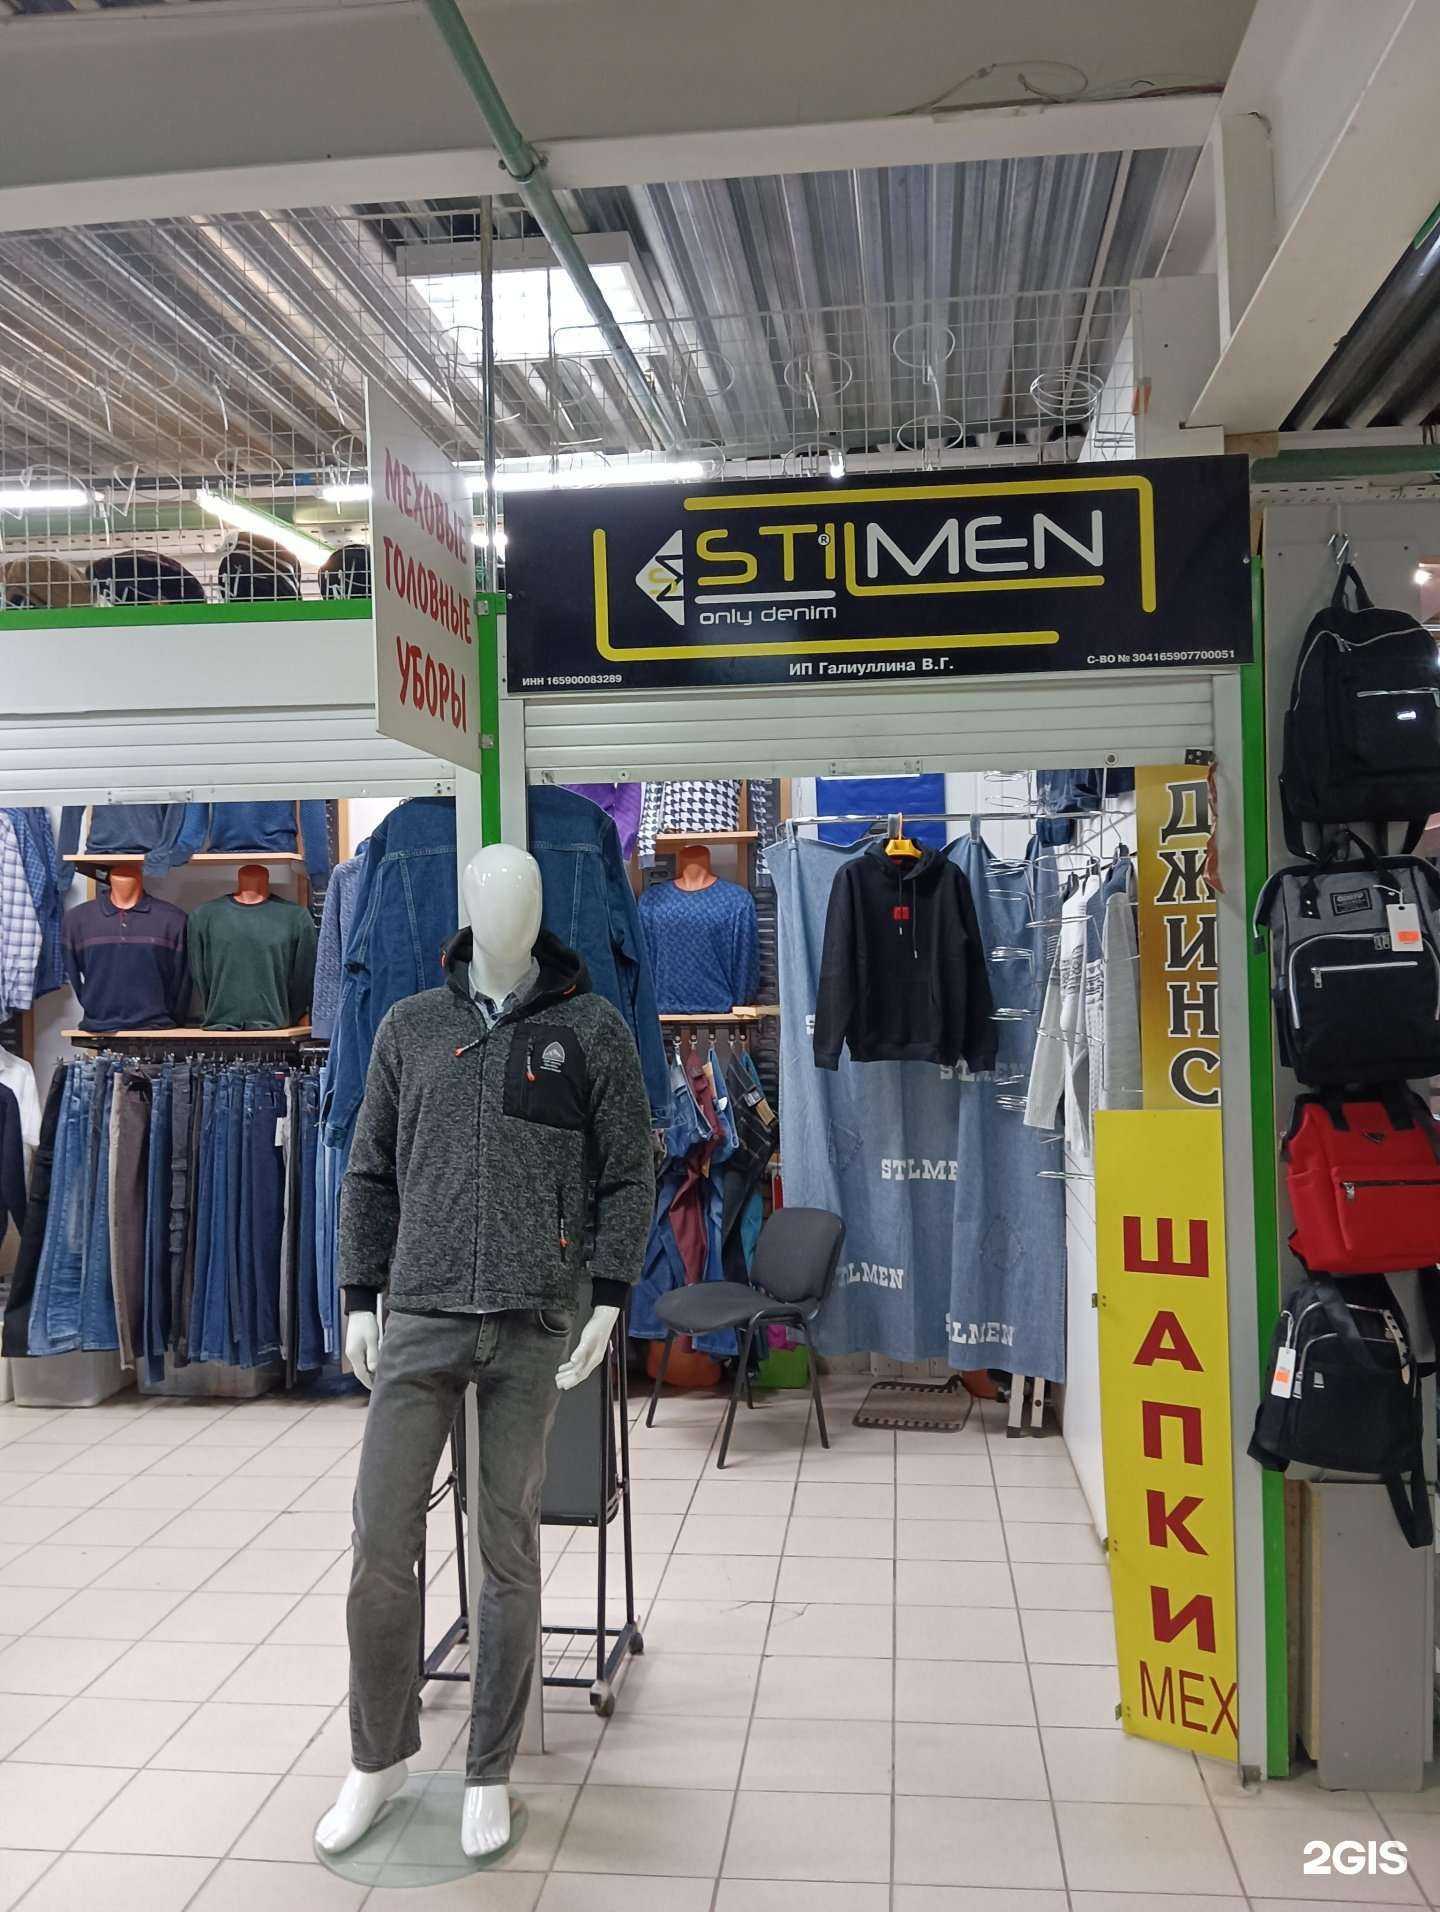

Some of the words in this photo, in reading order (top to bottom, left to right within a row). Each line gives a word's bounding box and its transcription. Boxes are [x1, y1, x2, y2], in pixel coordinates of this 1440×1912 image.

[384, 447, 468, 565] МЕХОВЫЕ
[382, 535, 473, 645] ГОЛОВНЫЕ
[695, 509, 1106, 597] STILMEN
[699, 608, 752, 626] only
[760, 604, 837, 622] denim
[396, 635, 468, 734] УБОРЫ
[522, 677, 545, 686] ИНН
[789, 662, 813, 676] ИП
[818, 660, 916, 676] Галиуллина
[922, 657, 954, 671] В.Г.
[1153, 779, 1221, 1107] ДЖИНС
[1122, 1214, 1218, 1654] ШАПКИ
[1139, 1659, 1239, 1740] МЕХ
